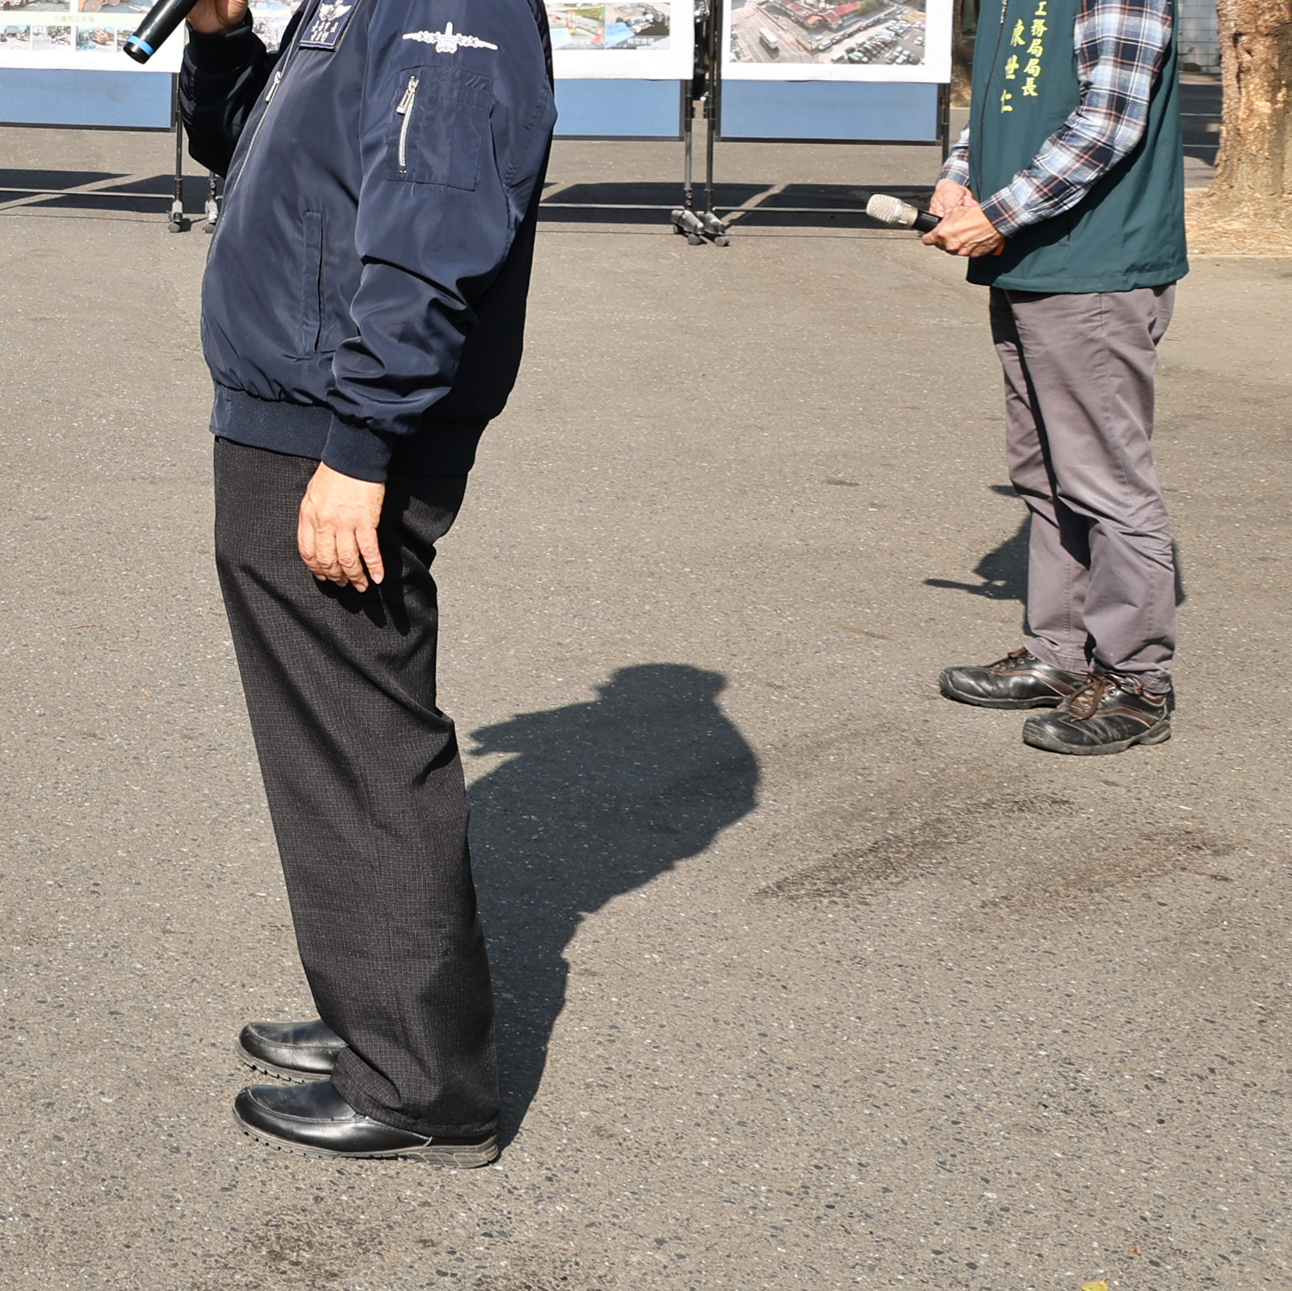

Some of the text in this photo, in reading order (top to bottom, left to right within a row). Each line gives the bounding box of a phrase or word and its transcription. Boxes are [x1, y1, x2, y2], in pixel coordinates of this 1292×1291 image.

[1000, 18, 1026, 114] 陳世仁
[1021, 0, 1048, 97] 工務局局長
